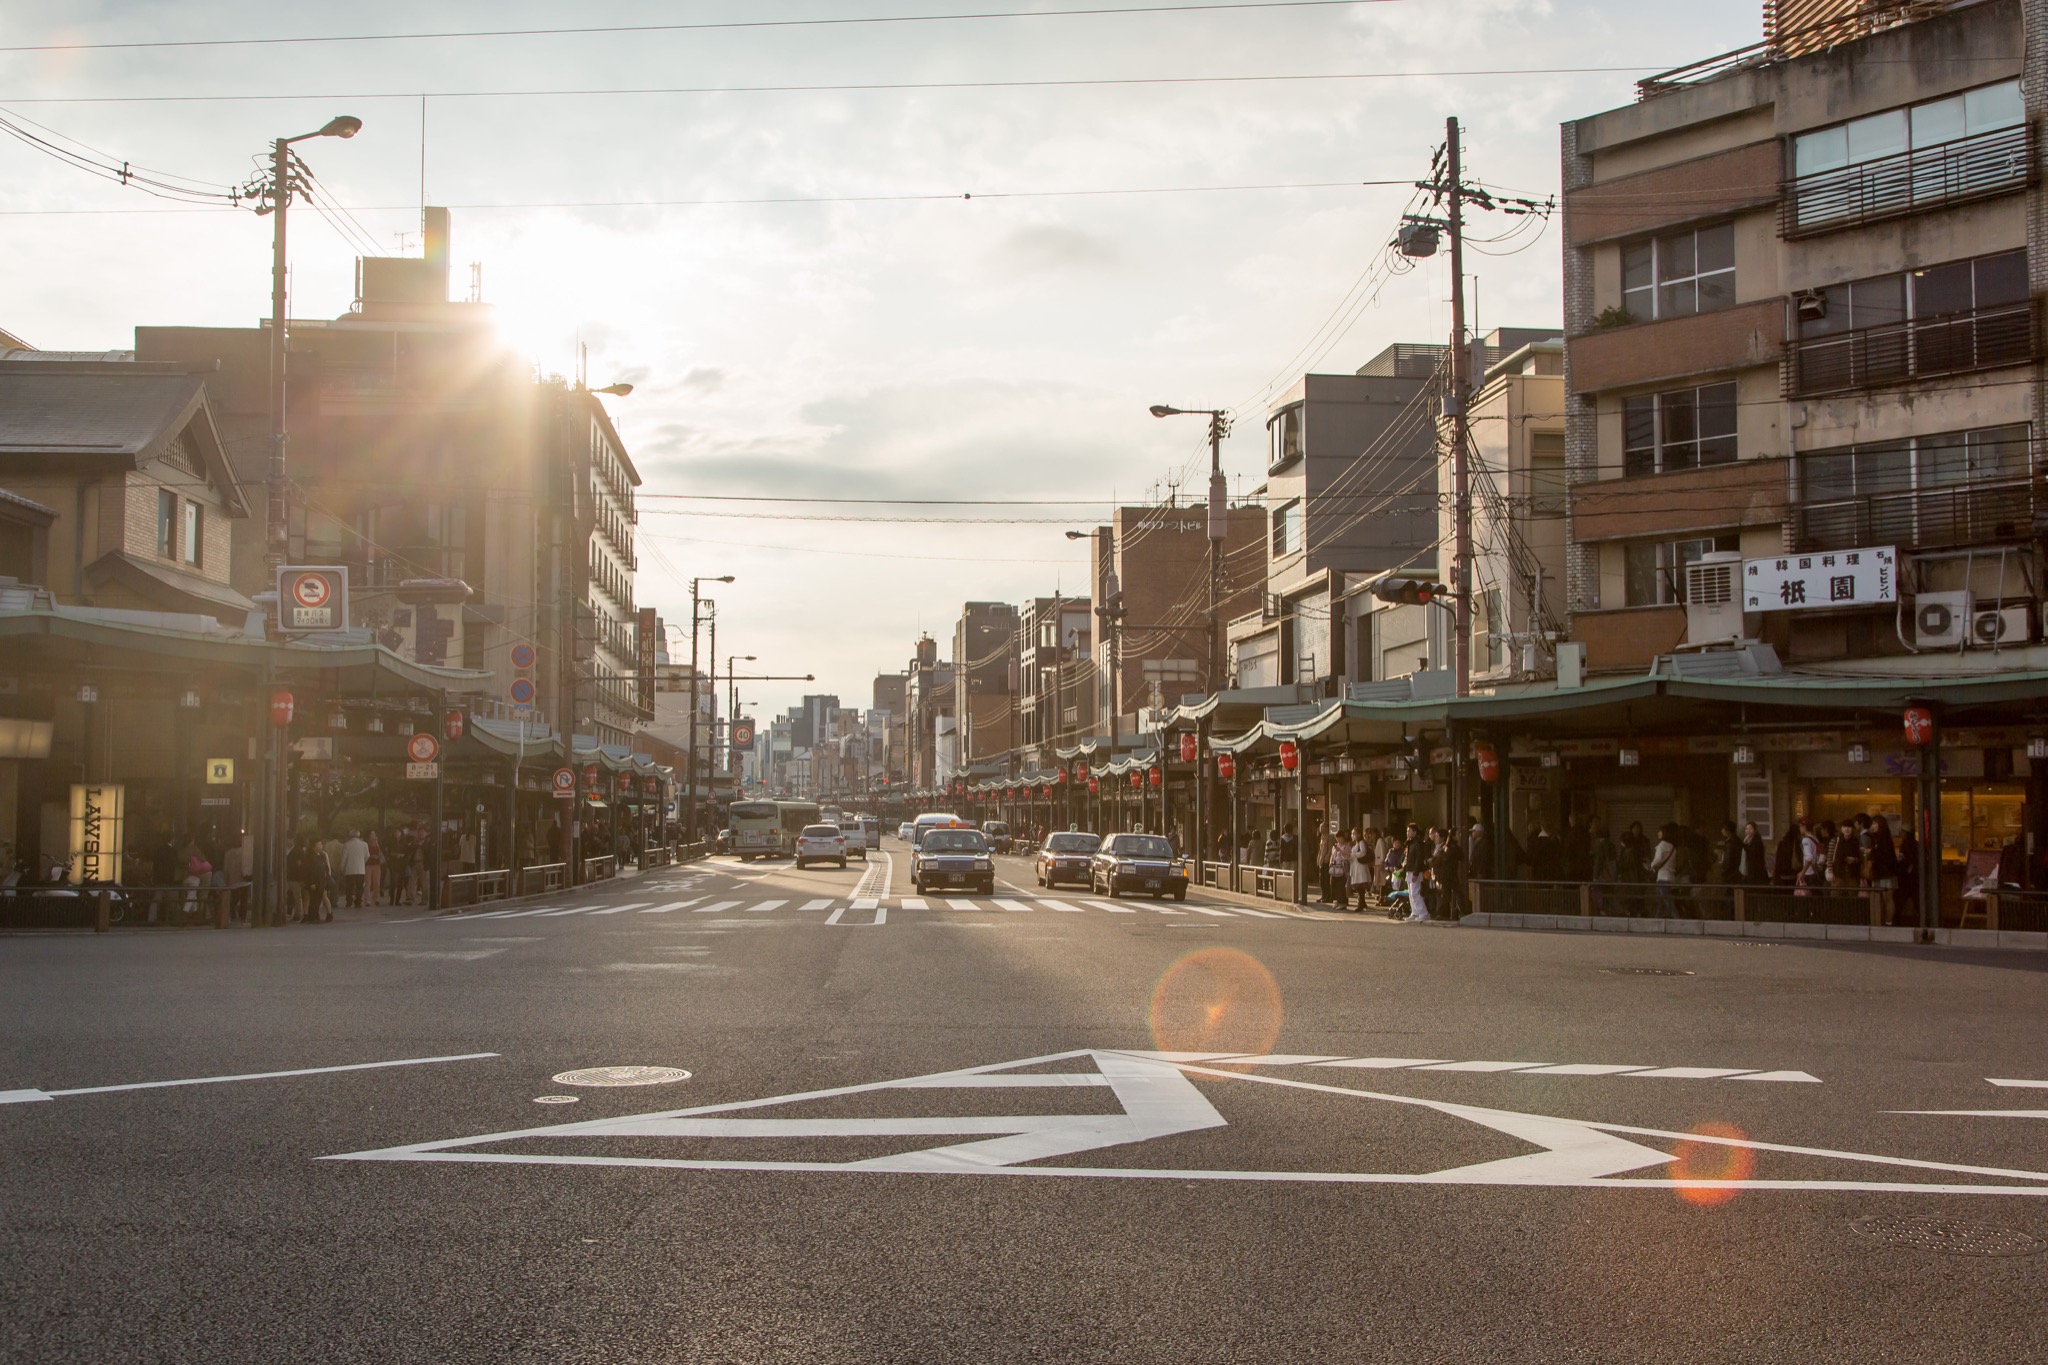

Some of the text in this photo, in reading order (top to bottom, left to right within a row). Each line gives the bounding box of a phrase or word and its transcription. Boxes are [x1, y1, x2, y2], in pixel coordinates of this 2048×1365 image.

[1775, 553, 1860, 572] 韓国料理
[1748, 566, 1759, 607] 焼肉
[1780, 574, 1856, 606] 祇園
[738, 730, 749, 740] 40
[83, 788, 102, 882] LAWSON
